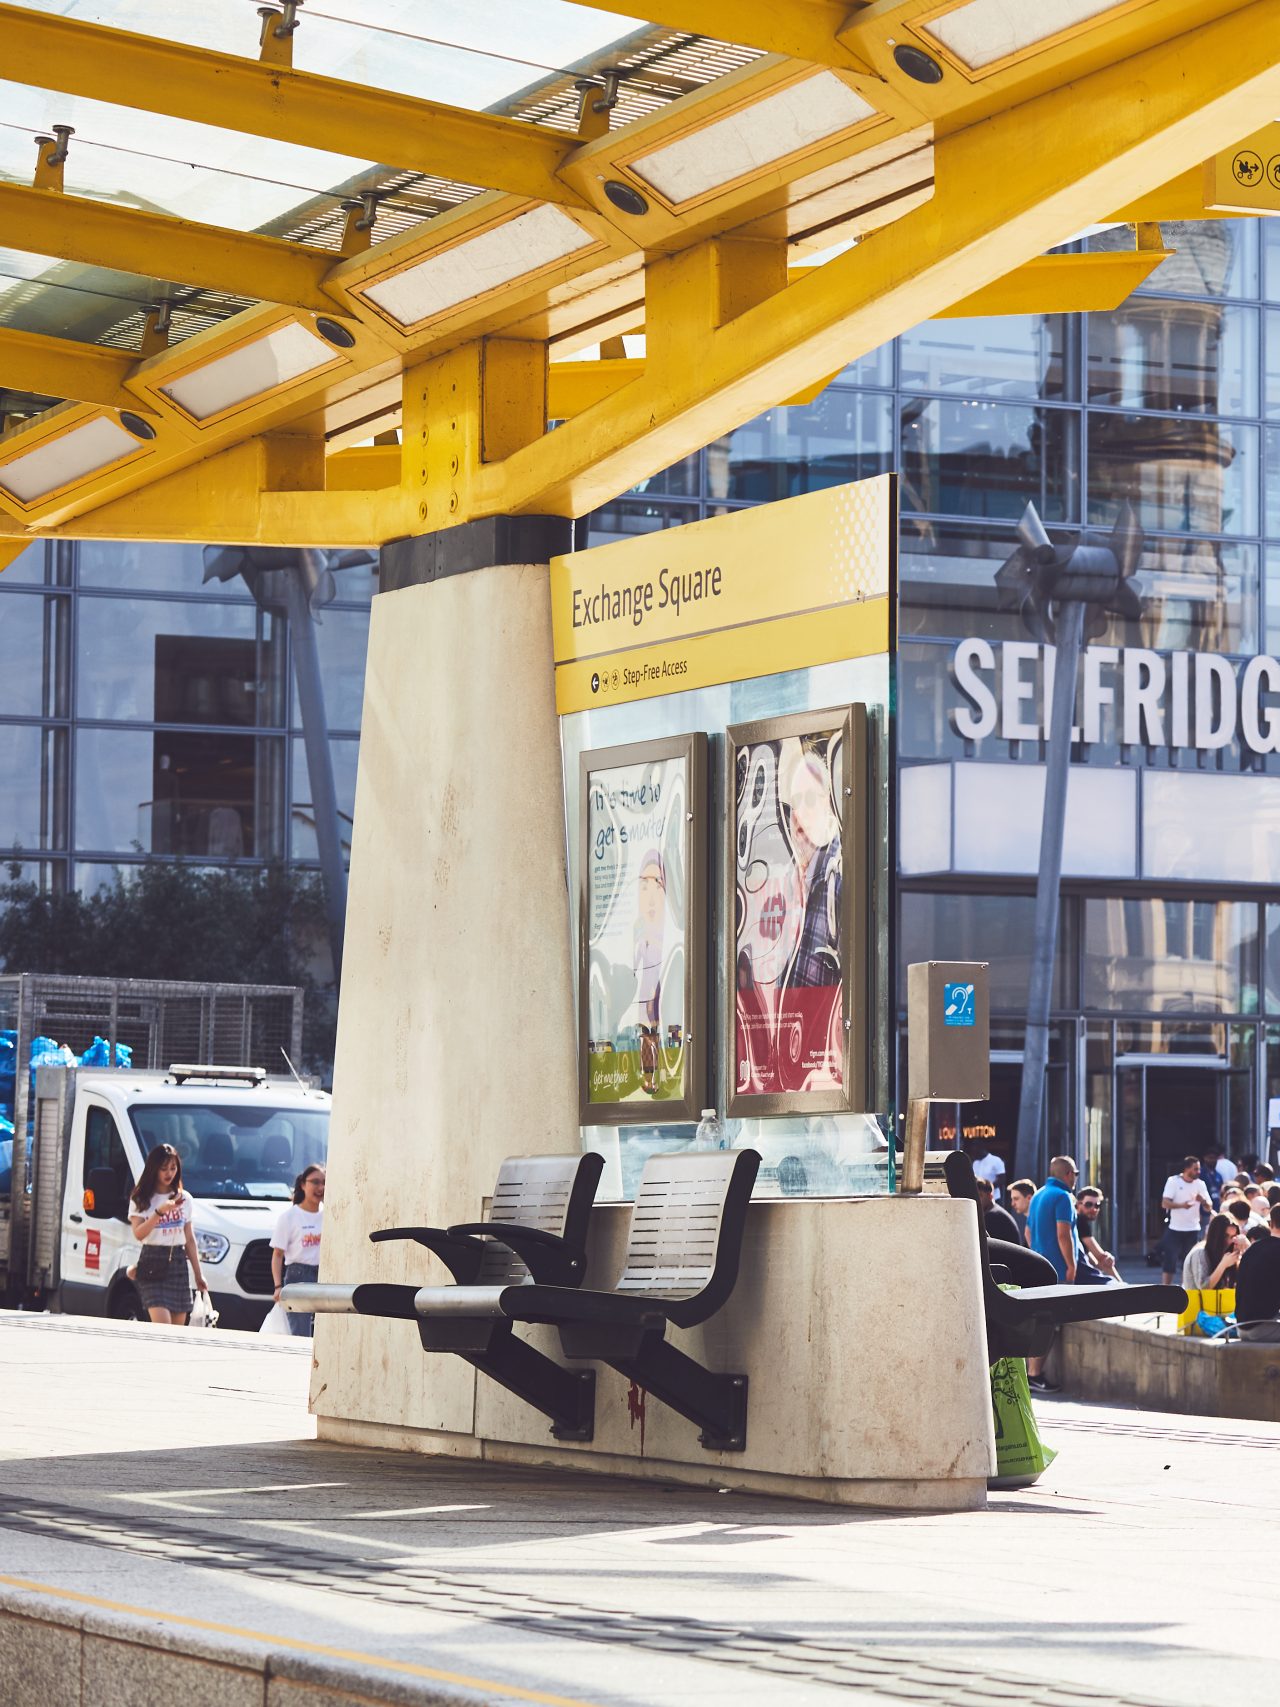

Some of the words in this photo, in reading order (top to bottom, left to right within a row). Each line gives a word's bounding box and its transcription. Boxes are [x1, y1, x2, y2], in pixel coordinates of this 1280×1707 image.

[572, 582, 653, 628] Exchange
[658, 566, 722, 616] Square
[623, 663, 660, 688] Step-Free
[662, 659, 688, 677] Access
[620, 779, 646, 807] time
[650, 776, 661, 802] to
[595, 823, 615, 859] get
[938, 1127, 957, 1140] LOU
[963, 1125, 996, 1138] VUITTON
